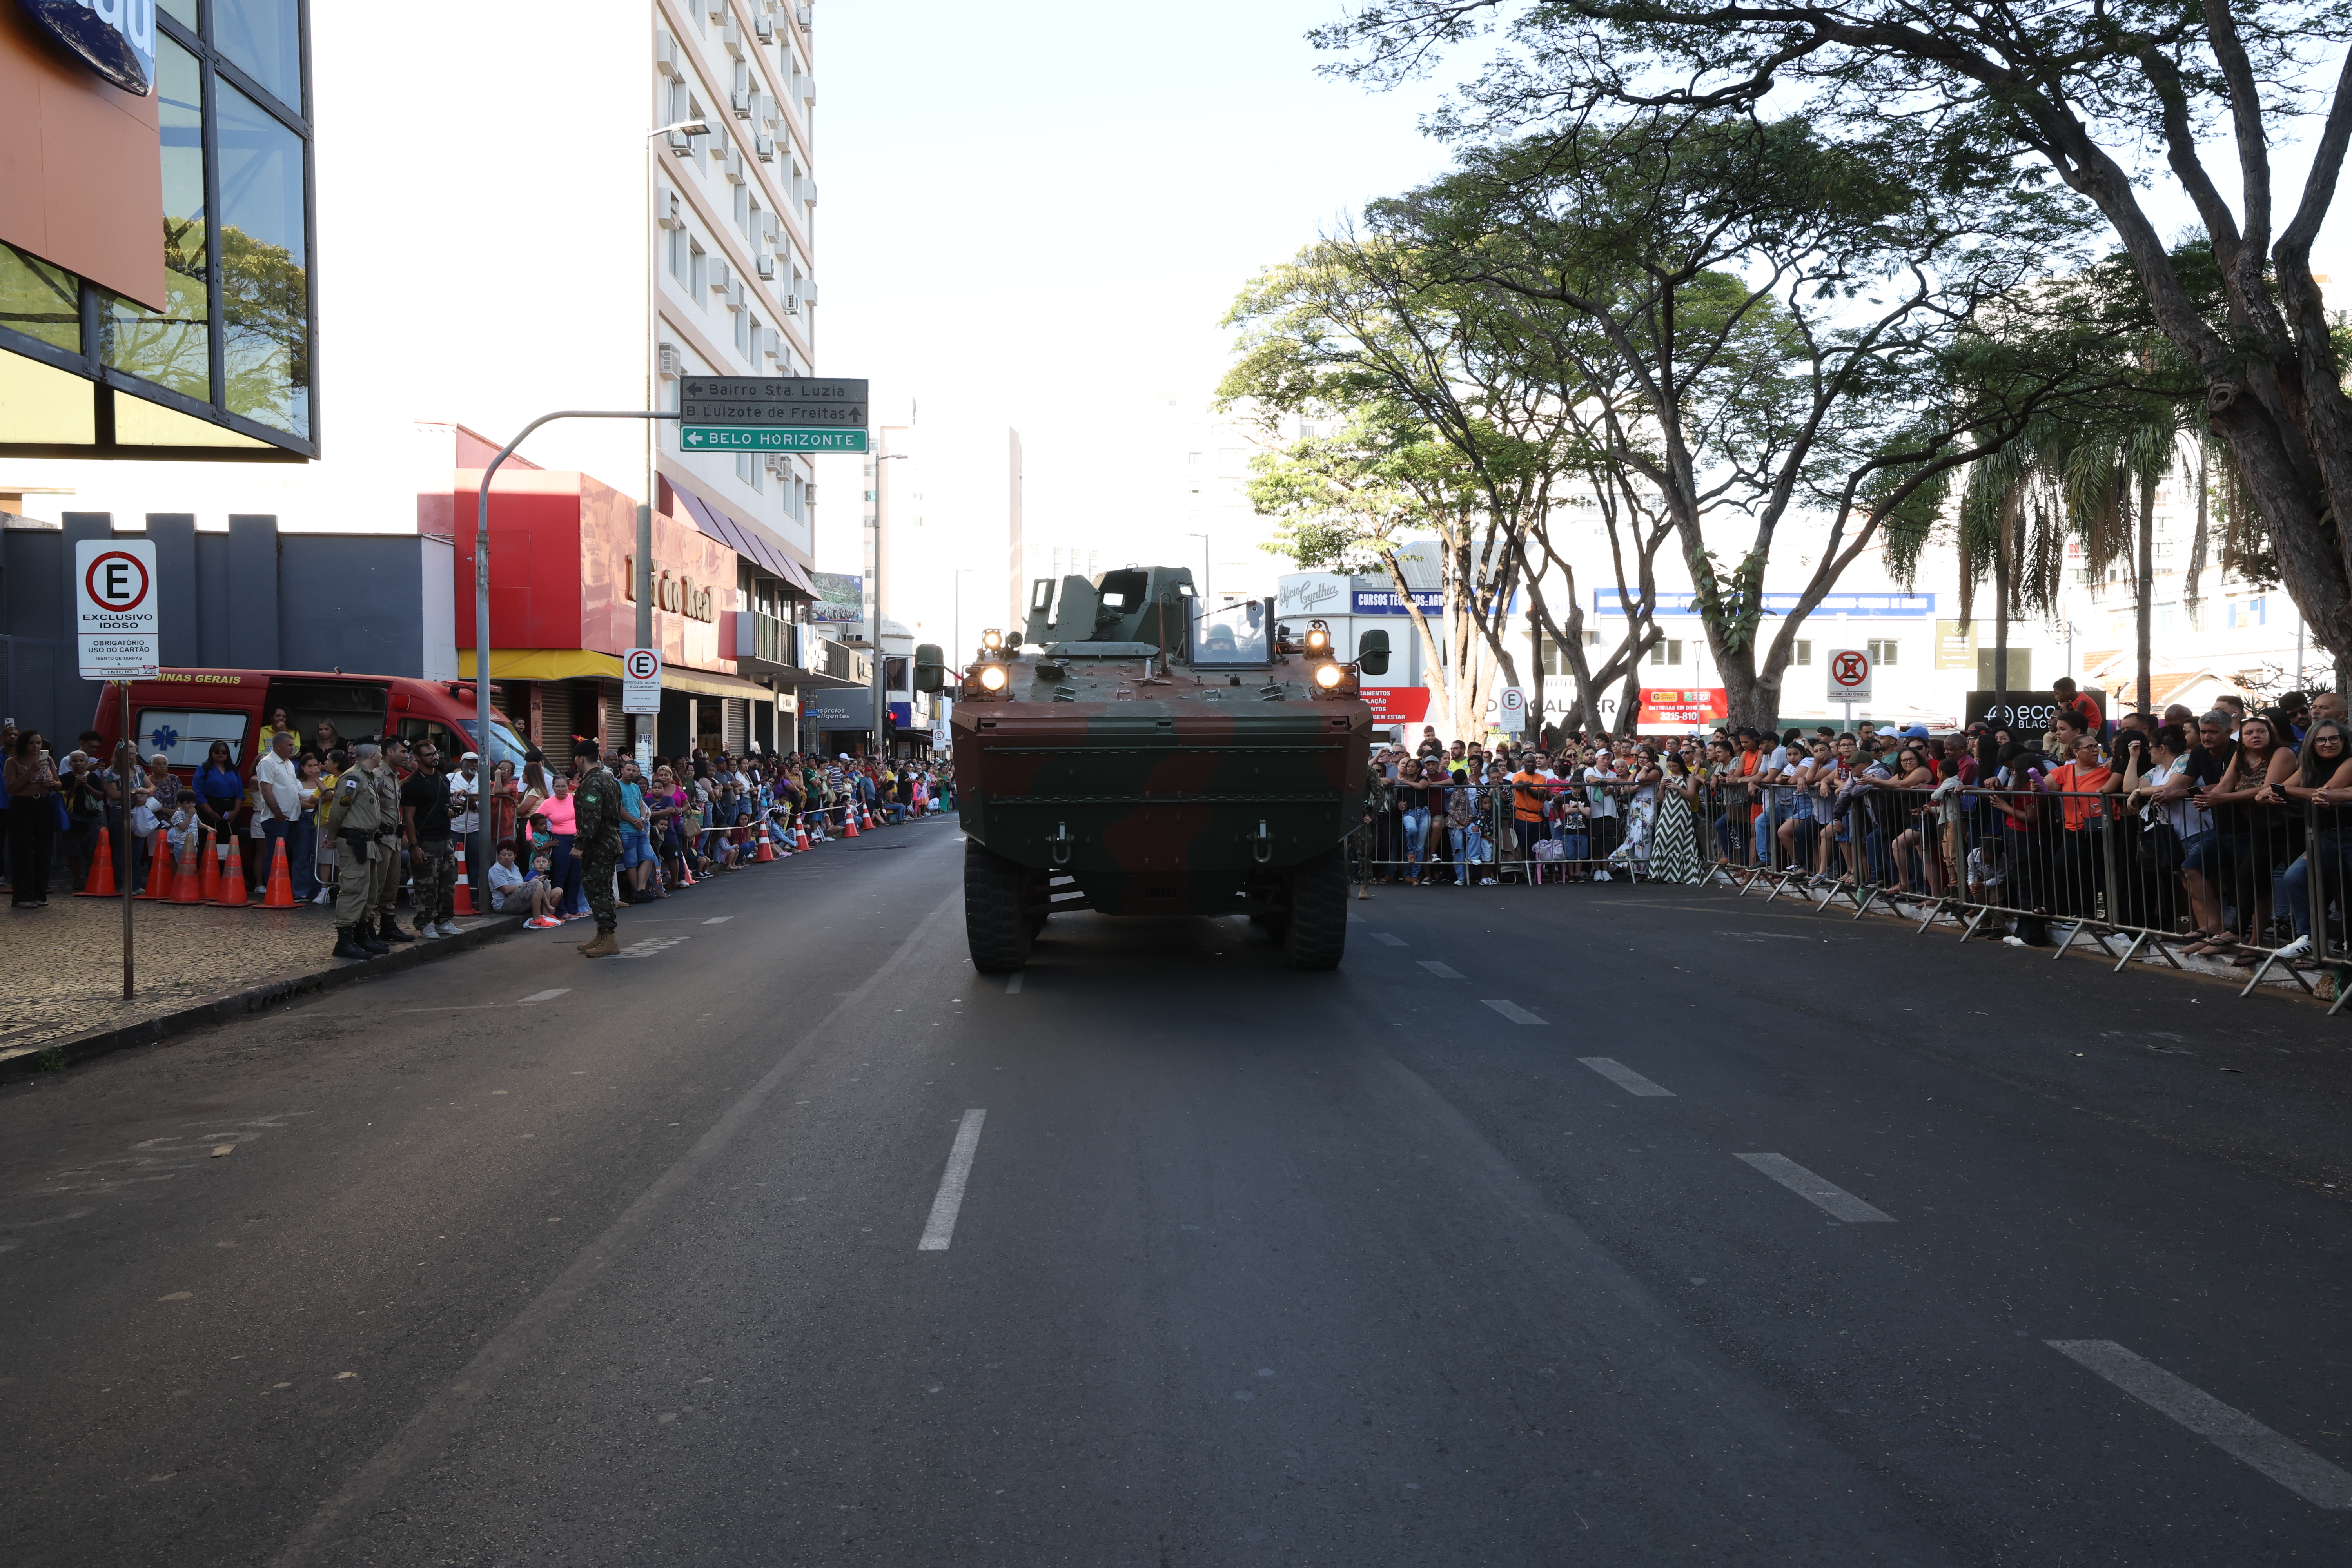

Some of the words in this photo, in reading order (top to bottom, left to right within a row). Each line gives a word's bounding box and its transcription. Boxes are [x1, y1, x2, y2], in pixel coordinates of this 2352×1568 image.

[710, 384, 756, 396] Bairro
[765, 385, 794, 396] Sta.
[802, 385, 844, 397] Luzia
[686, 406, 699, 416] B.
[703, 406, 762, 417] Luizote
[768, 407, 784, 417] de
[792, 408, 845, 419] Freitas
[710, 433, 751, 444] BELO
[760, 434, 854, 446] HORIZONTE
[107, 564, 129, 598] E
[659, 570, 681, 613] do
[681, 576, 714, 623] Real
[1358, 593, 1388, 606] CURSOS
[636, 657, 649, 673] E
[195, 675, 241, 684] GERAIS
[1508, 694, 1515, 706] E
[1660, 712, 1699, 720] 3215-810
[2018, 720, 2050, 728] BLAC
